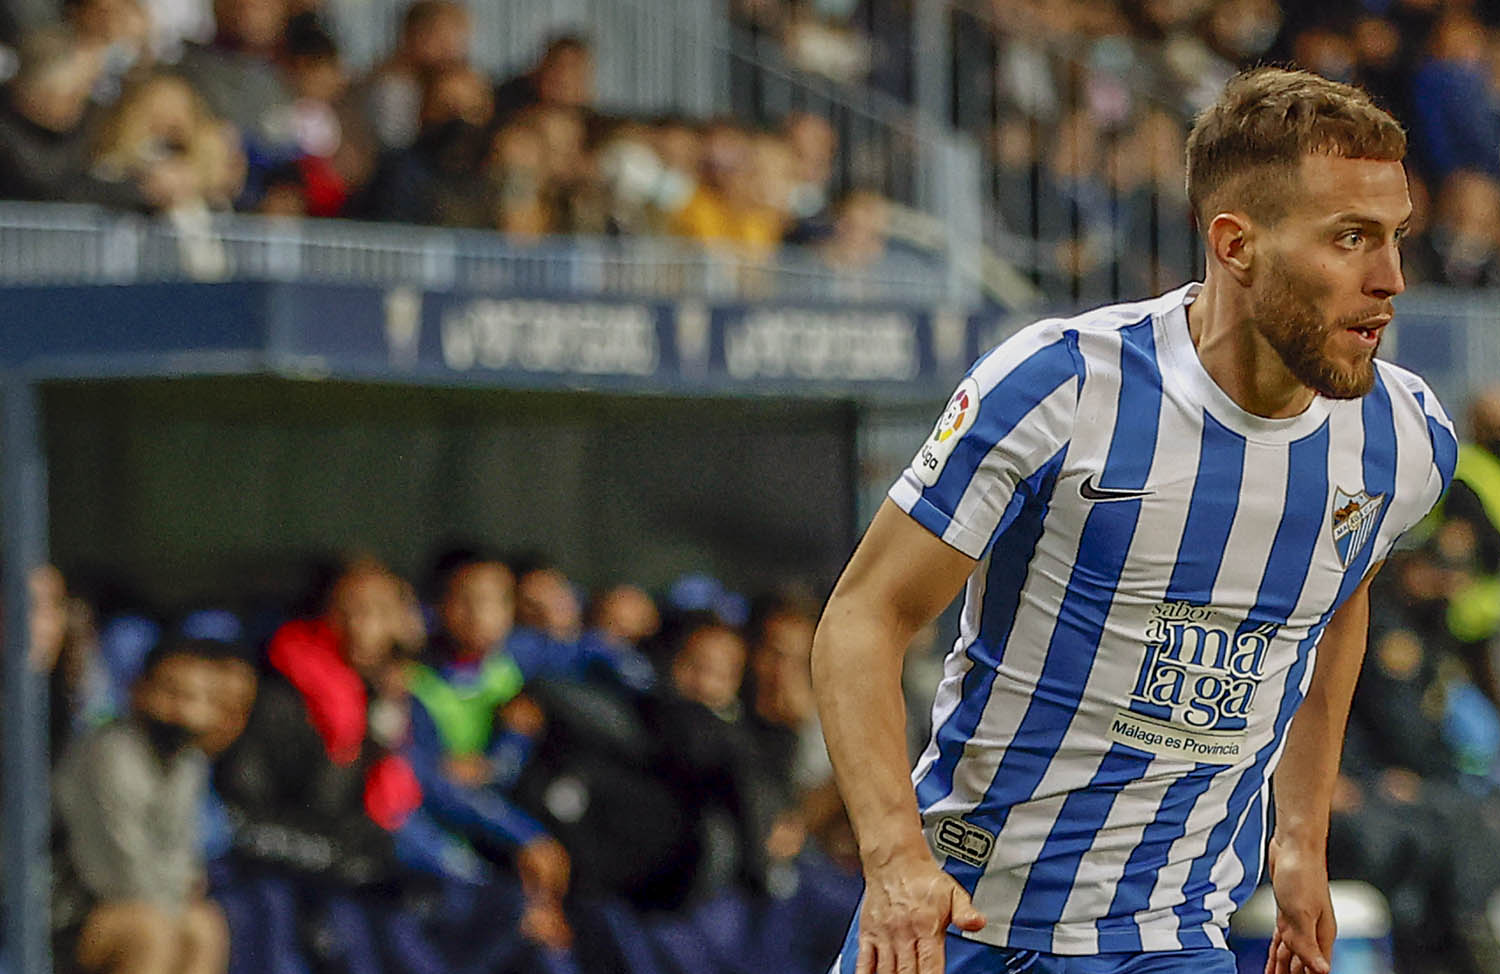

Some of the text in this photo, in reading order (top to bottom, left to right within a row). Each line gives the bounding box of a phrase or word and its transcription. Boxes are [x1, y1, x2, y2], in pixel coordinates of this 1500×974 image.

[1152, 601, 1217, 621] sabor
[1146, 618, 1167, 643] a
[1130, 643, 1258, 729] laga
[1111, 719, 1240, 756] Málaga es Provincia
